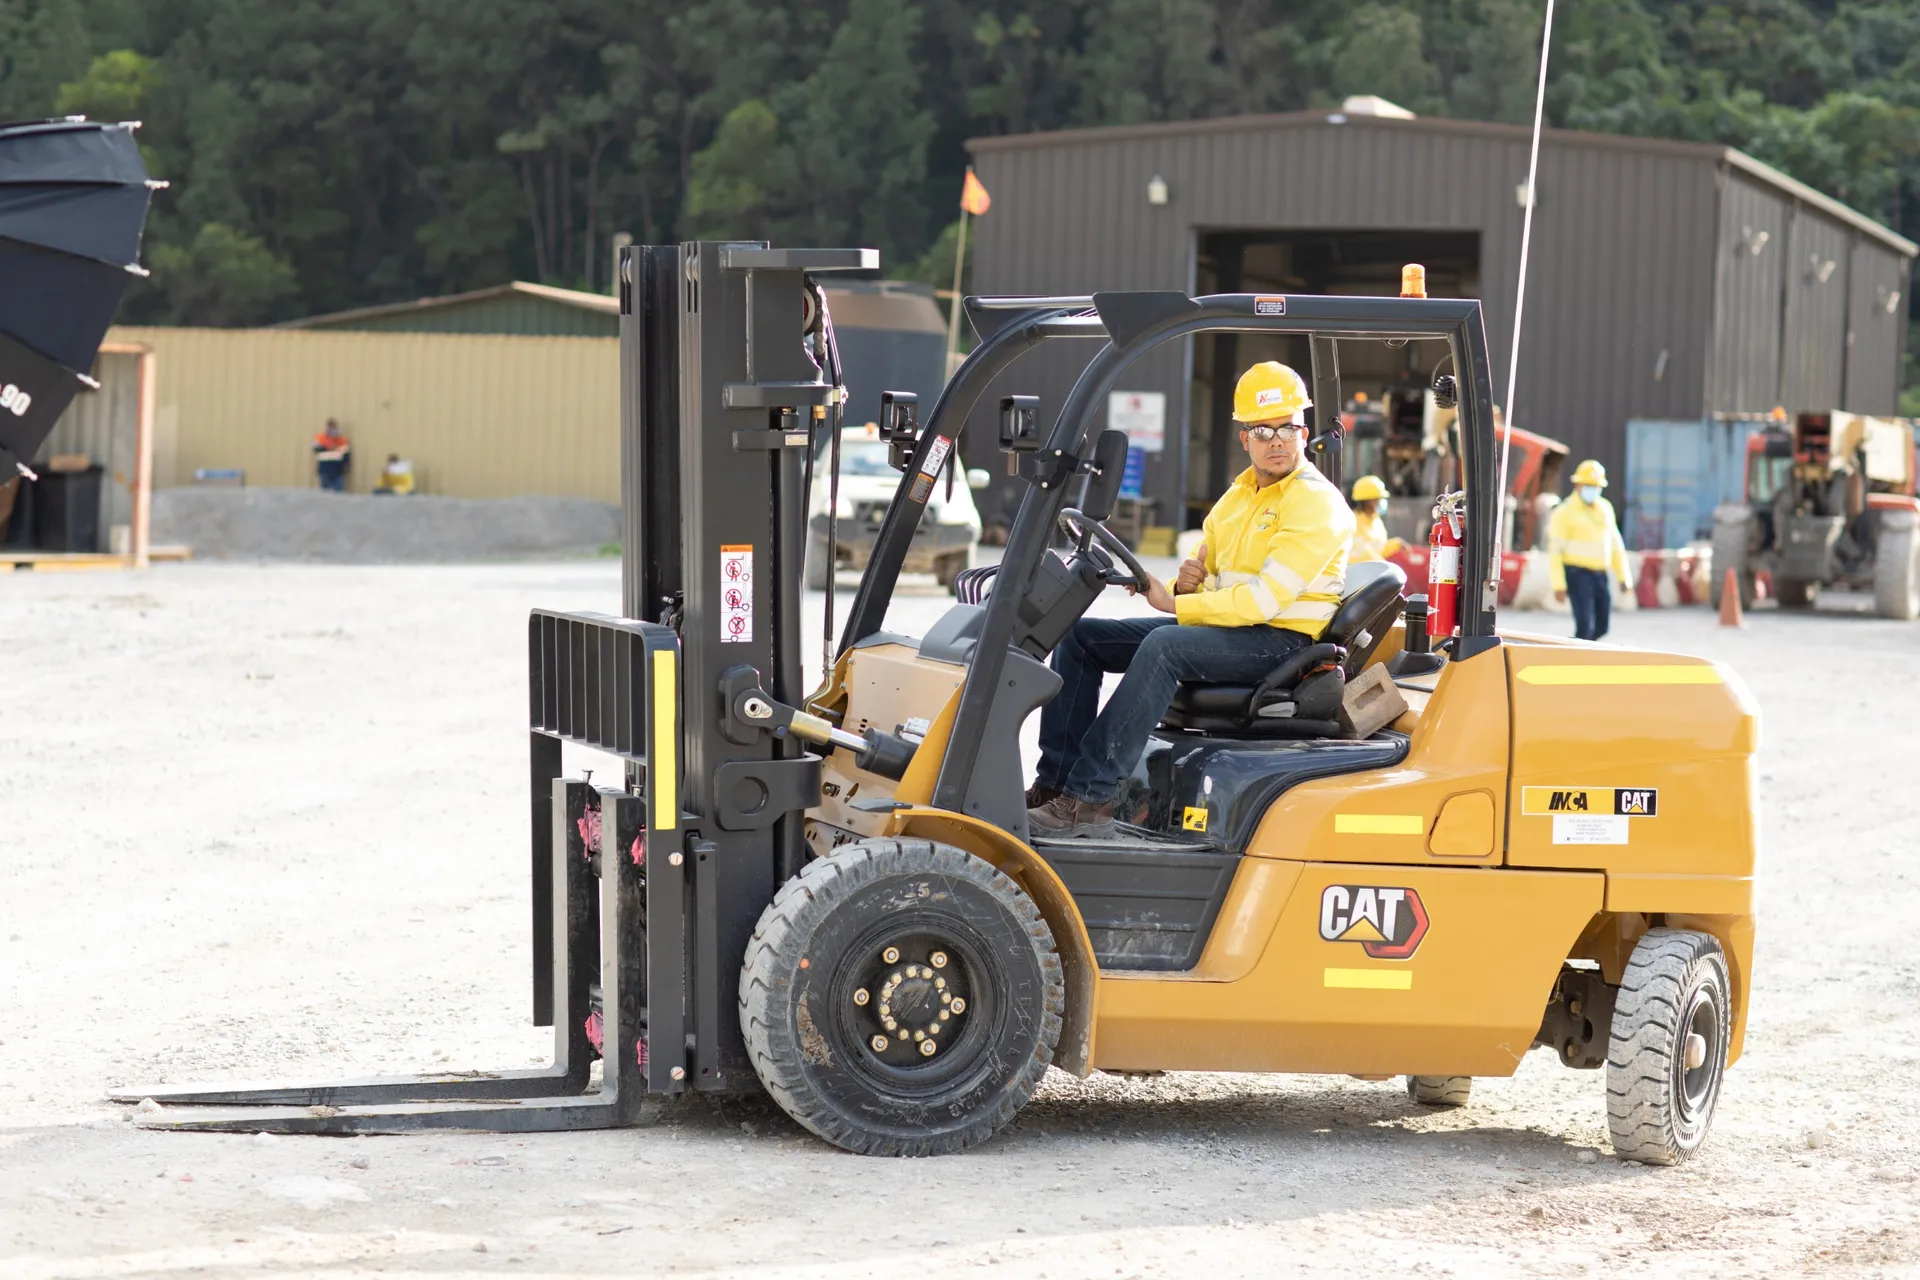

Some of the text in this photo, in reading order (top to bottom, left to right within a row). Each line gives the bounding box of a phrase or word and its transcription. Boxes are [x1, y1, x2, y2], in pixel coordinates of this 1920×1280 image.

[1548, 791, 1588, 811] IMCA
[1621, 791, 1650, 813] CAT
[1321, 886, 1405, 941] CAT
